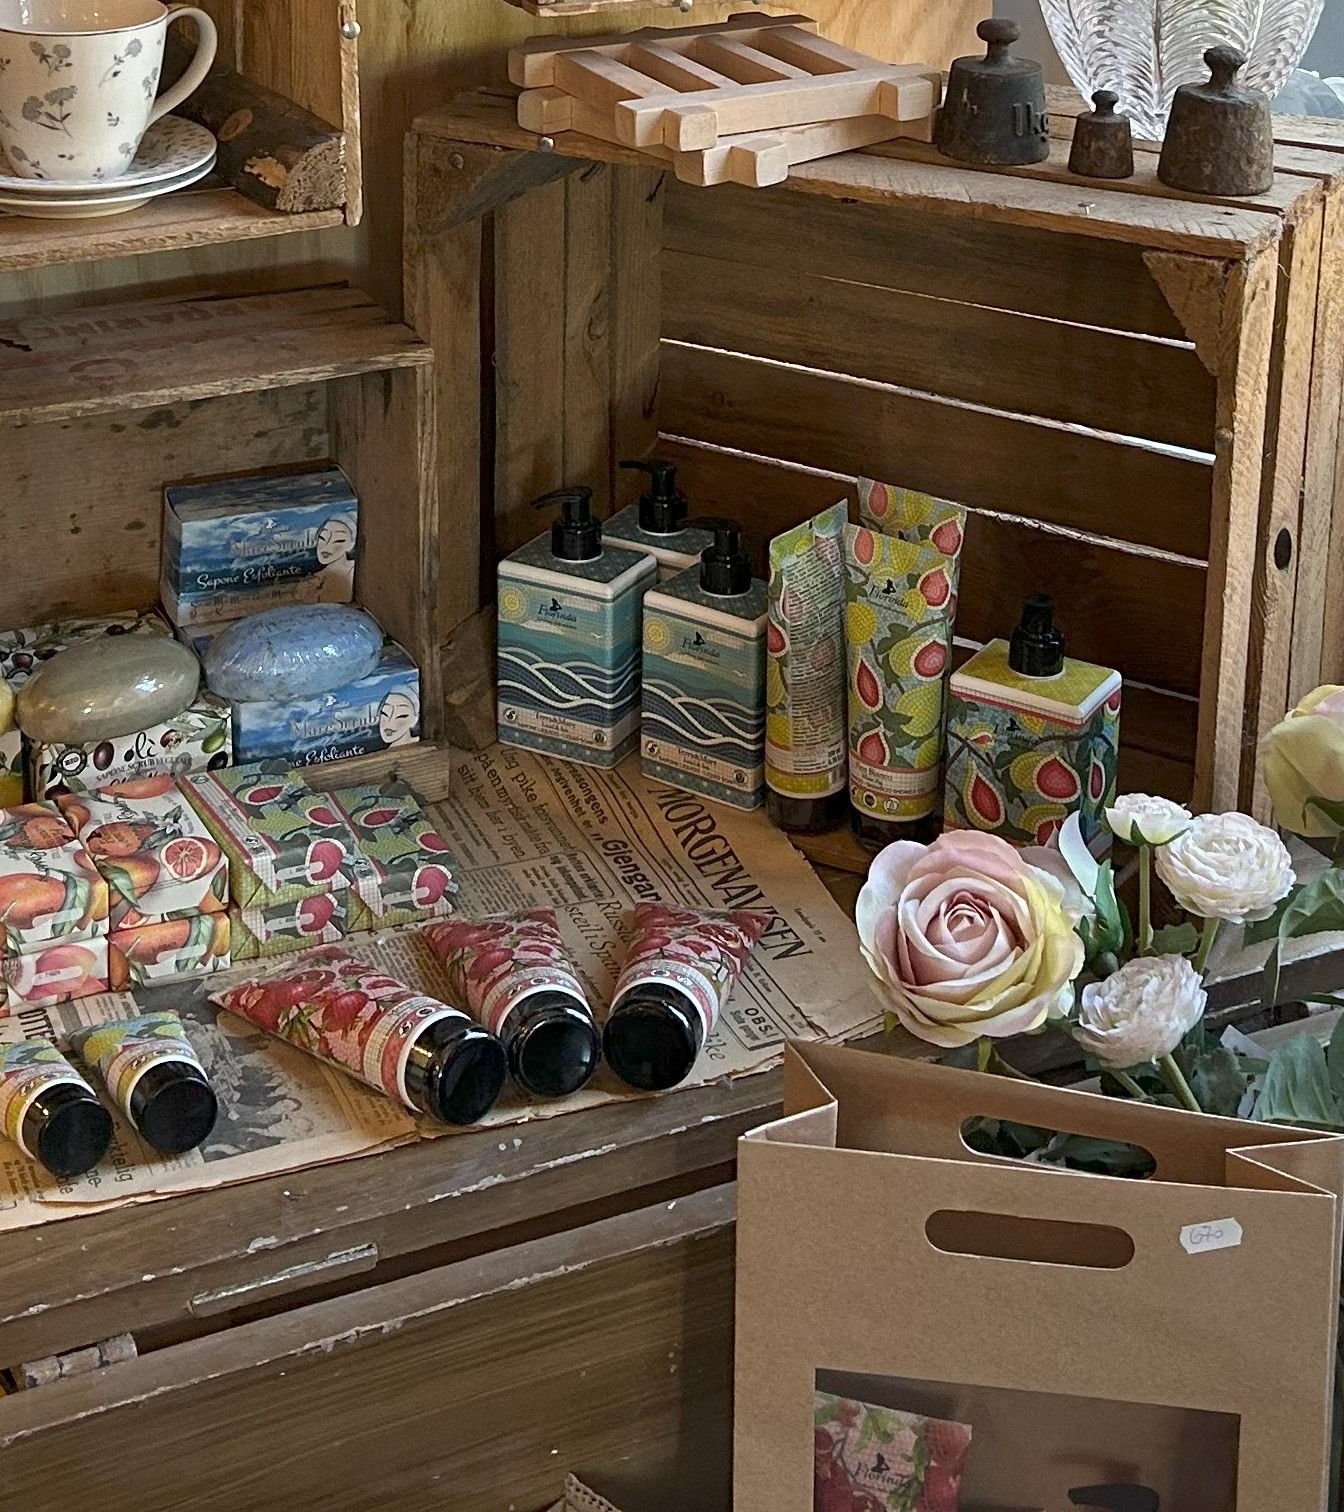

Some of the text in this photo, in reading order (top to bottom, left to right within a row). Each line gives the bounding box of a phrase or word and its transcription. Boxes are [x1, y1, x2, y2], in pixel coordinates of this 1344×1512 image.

[197, 565, 302, 591] Sapone Esfoliante
[306, 744, 366, 766] Esfoliante
[512, 770, 542, 803] pike
